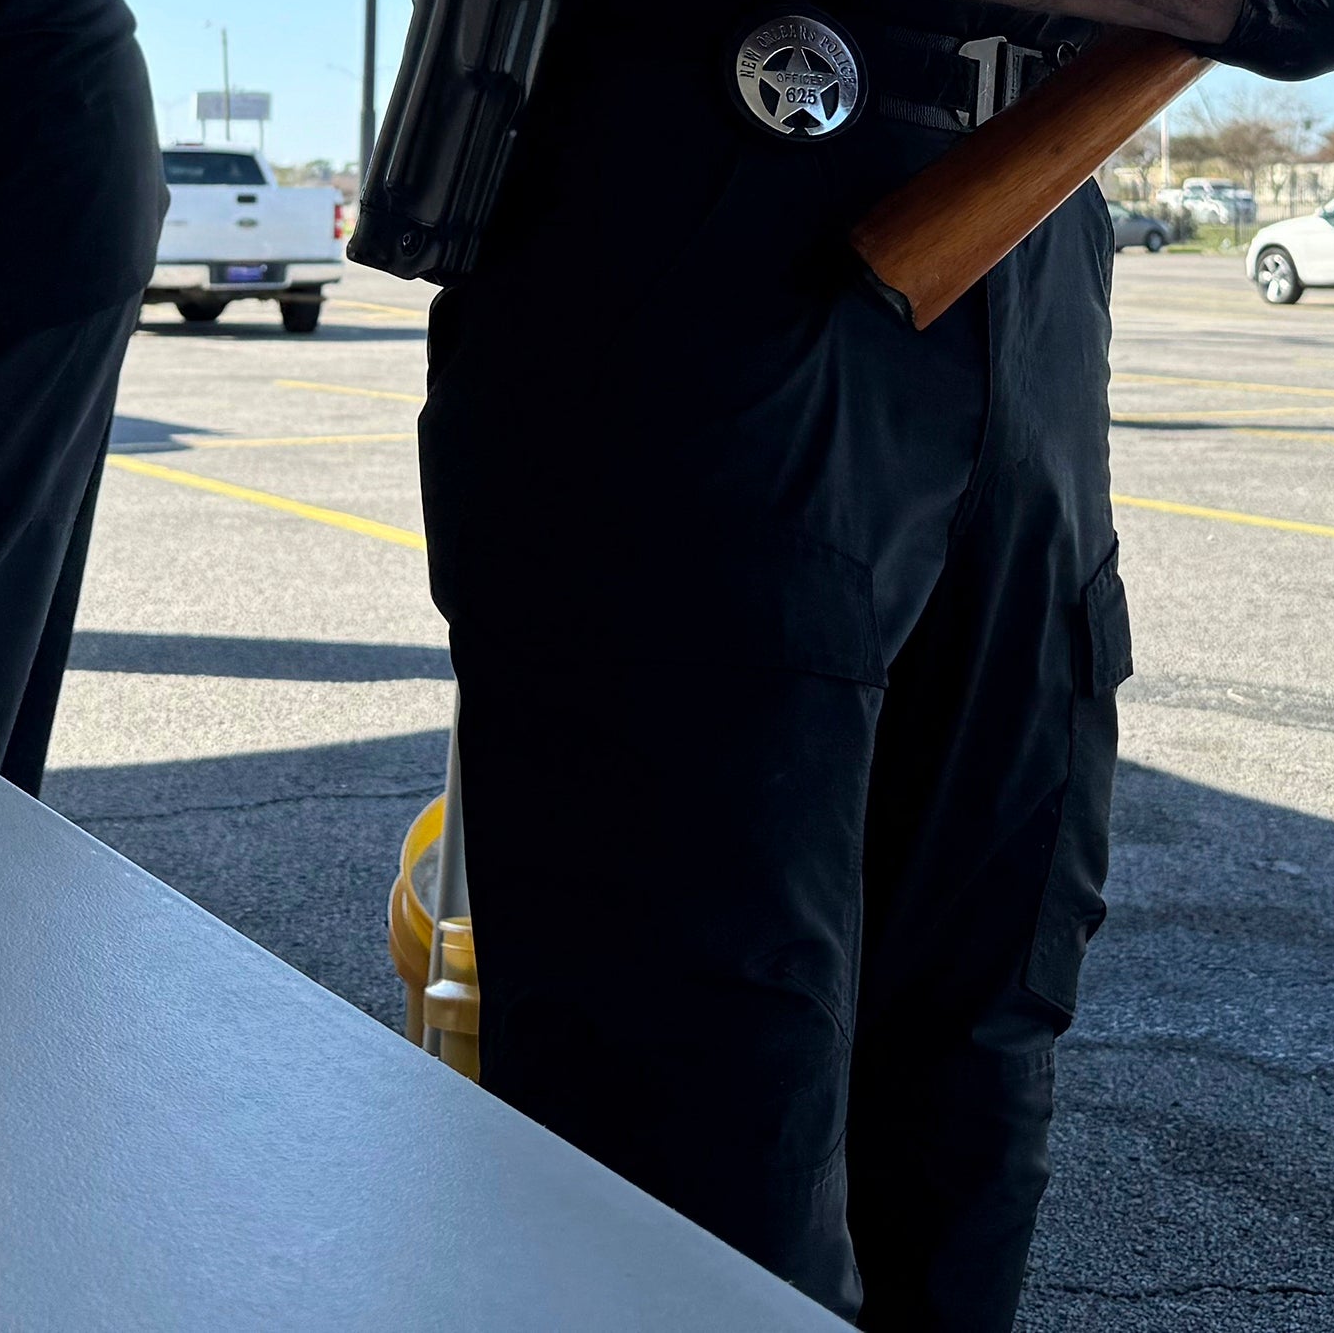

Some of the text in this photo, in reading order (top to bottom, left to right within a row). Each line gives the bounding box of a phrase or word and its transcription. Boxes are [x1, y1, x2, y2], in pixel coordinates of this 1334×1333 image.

[739, 24, 857, 91] NEW ORLEANS POLICE
[776, 72, 825, 86] OFFICER
[785, 87, 818, 105] 625
